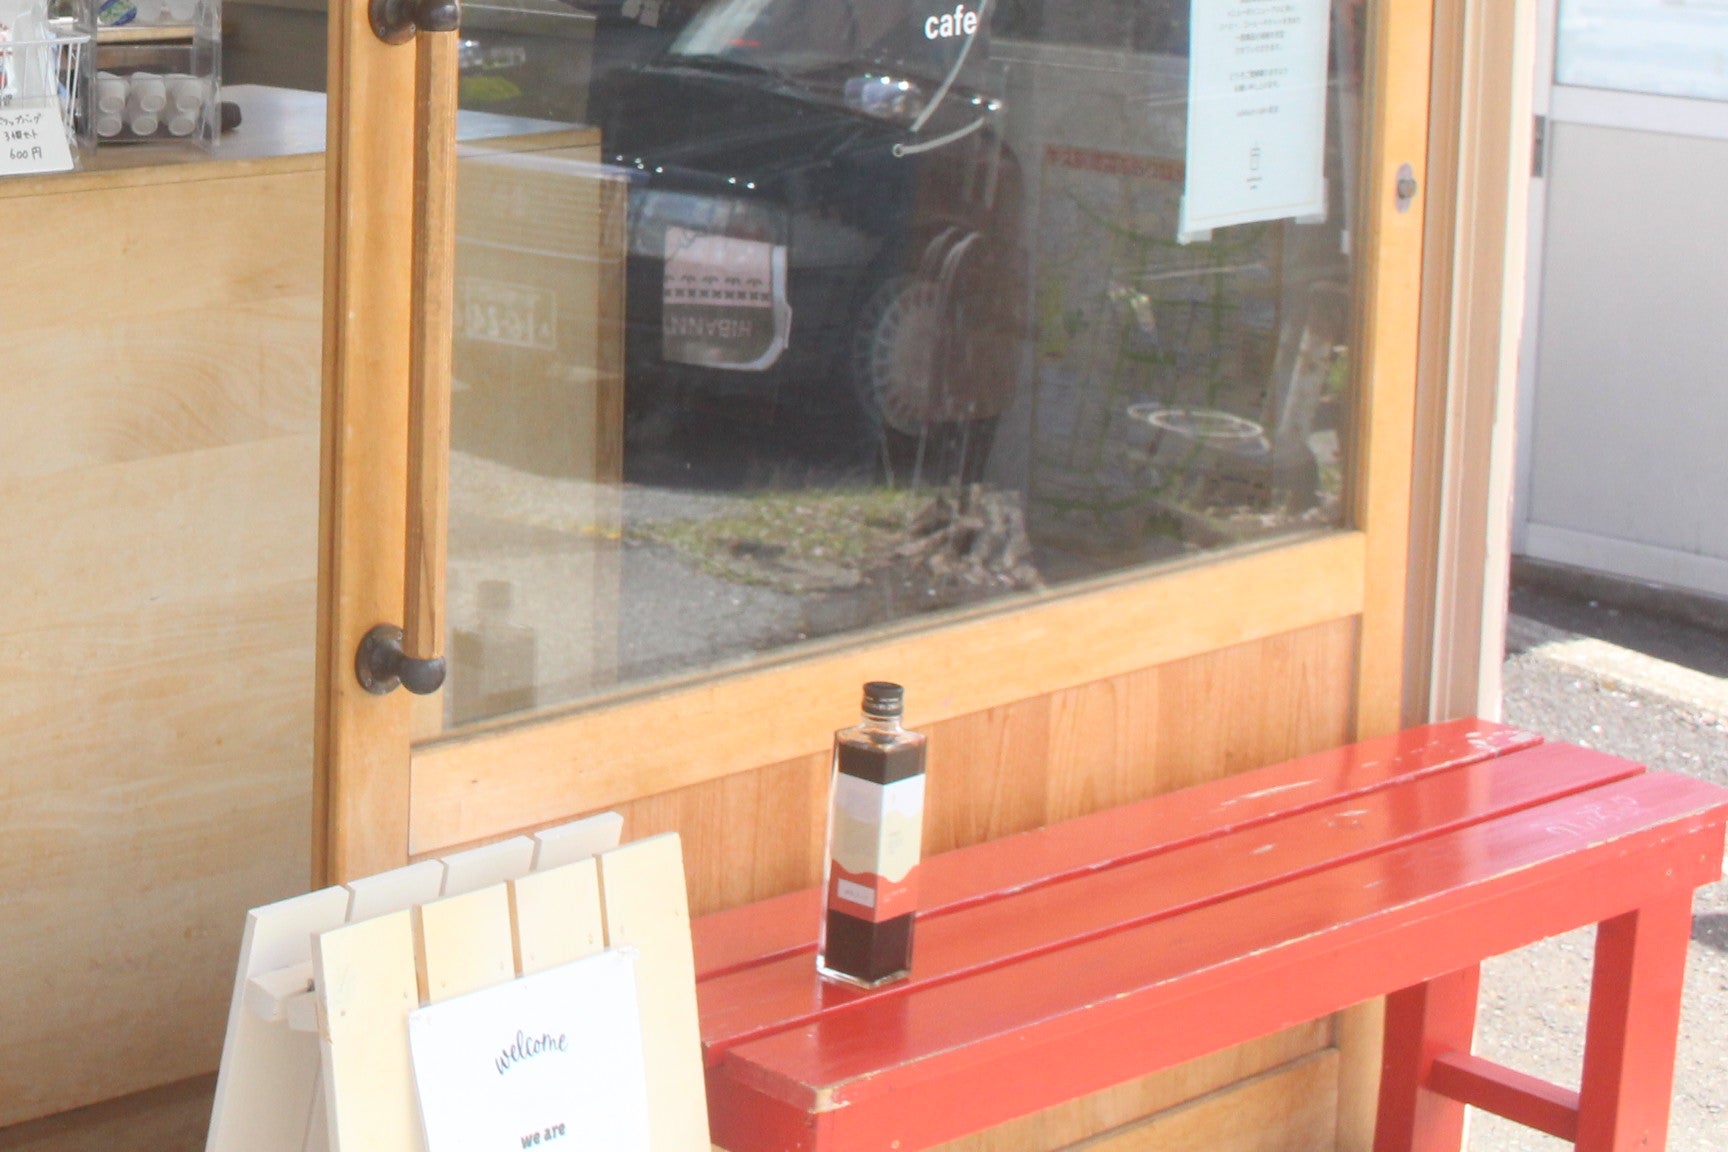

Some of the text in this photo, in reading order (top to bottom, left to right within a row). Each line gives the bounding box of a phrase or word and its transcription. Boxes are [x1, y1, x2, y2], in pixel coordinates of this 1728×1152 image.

[924, 4, 978, 40] cafe
[10, 146, 43, 160] 600円
[495, 1029, 569, 1076] welcome
[520, 1123, 566, 1149] we are
